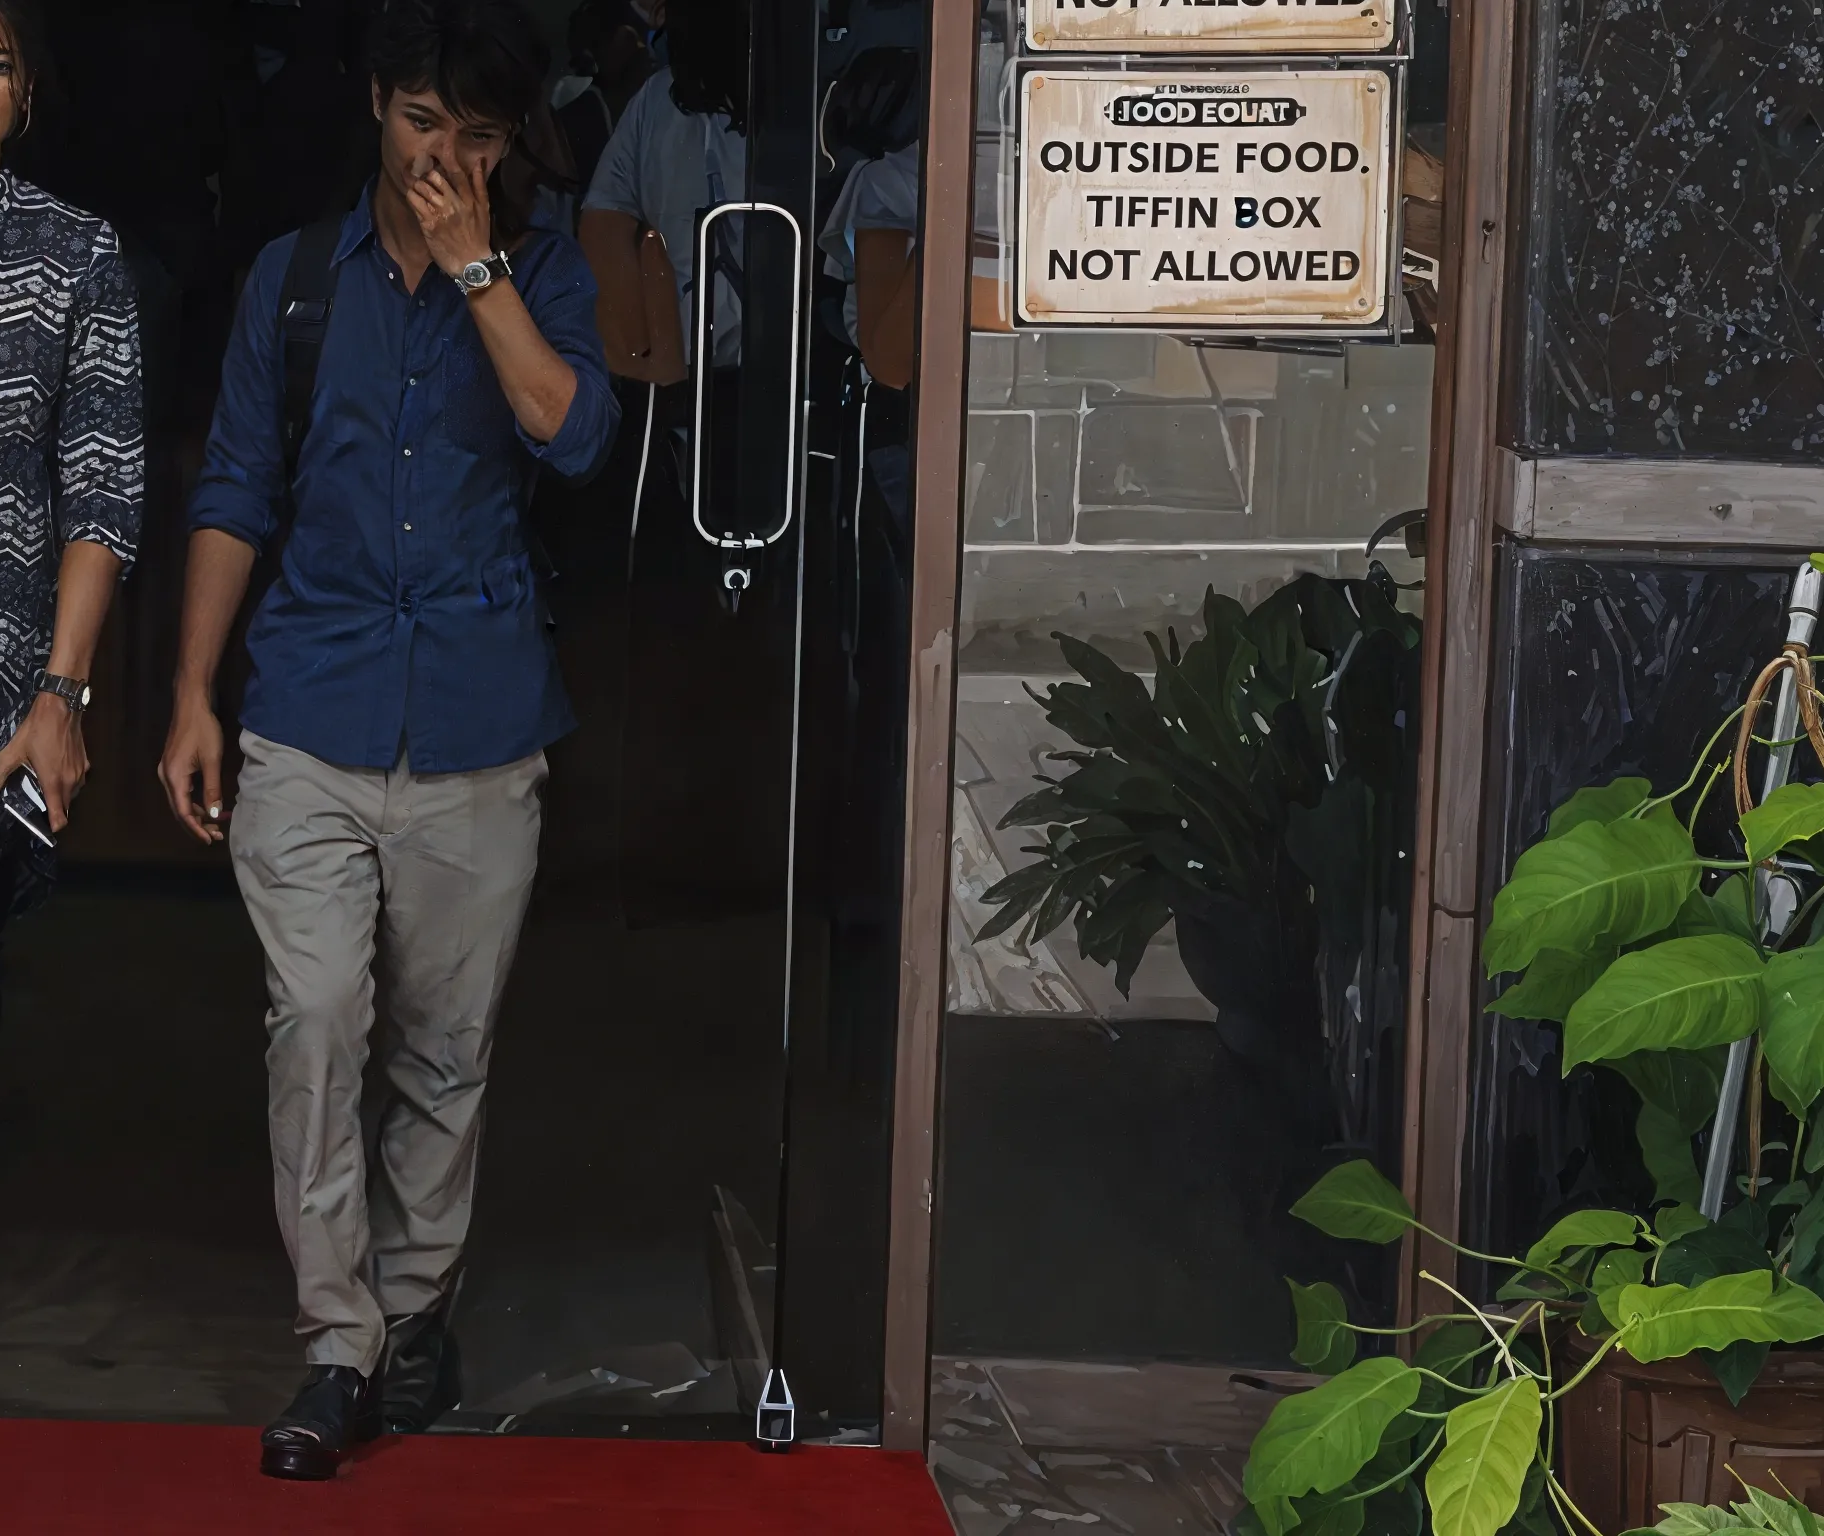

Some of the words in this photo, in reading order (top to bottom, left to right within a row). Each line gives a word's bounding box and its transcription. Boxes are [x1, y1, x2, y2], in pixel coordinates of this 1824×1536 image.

[1235, 140, 1371, 175] FOOD.
[1086, 194, 1219, 229] TIFFIN
[1233, 195, 1323, 229] BOX
[1047, 248, 1142, 281] NOT
[1150, 249, 1362, 283] ALLOWED
